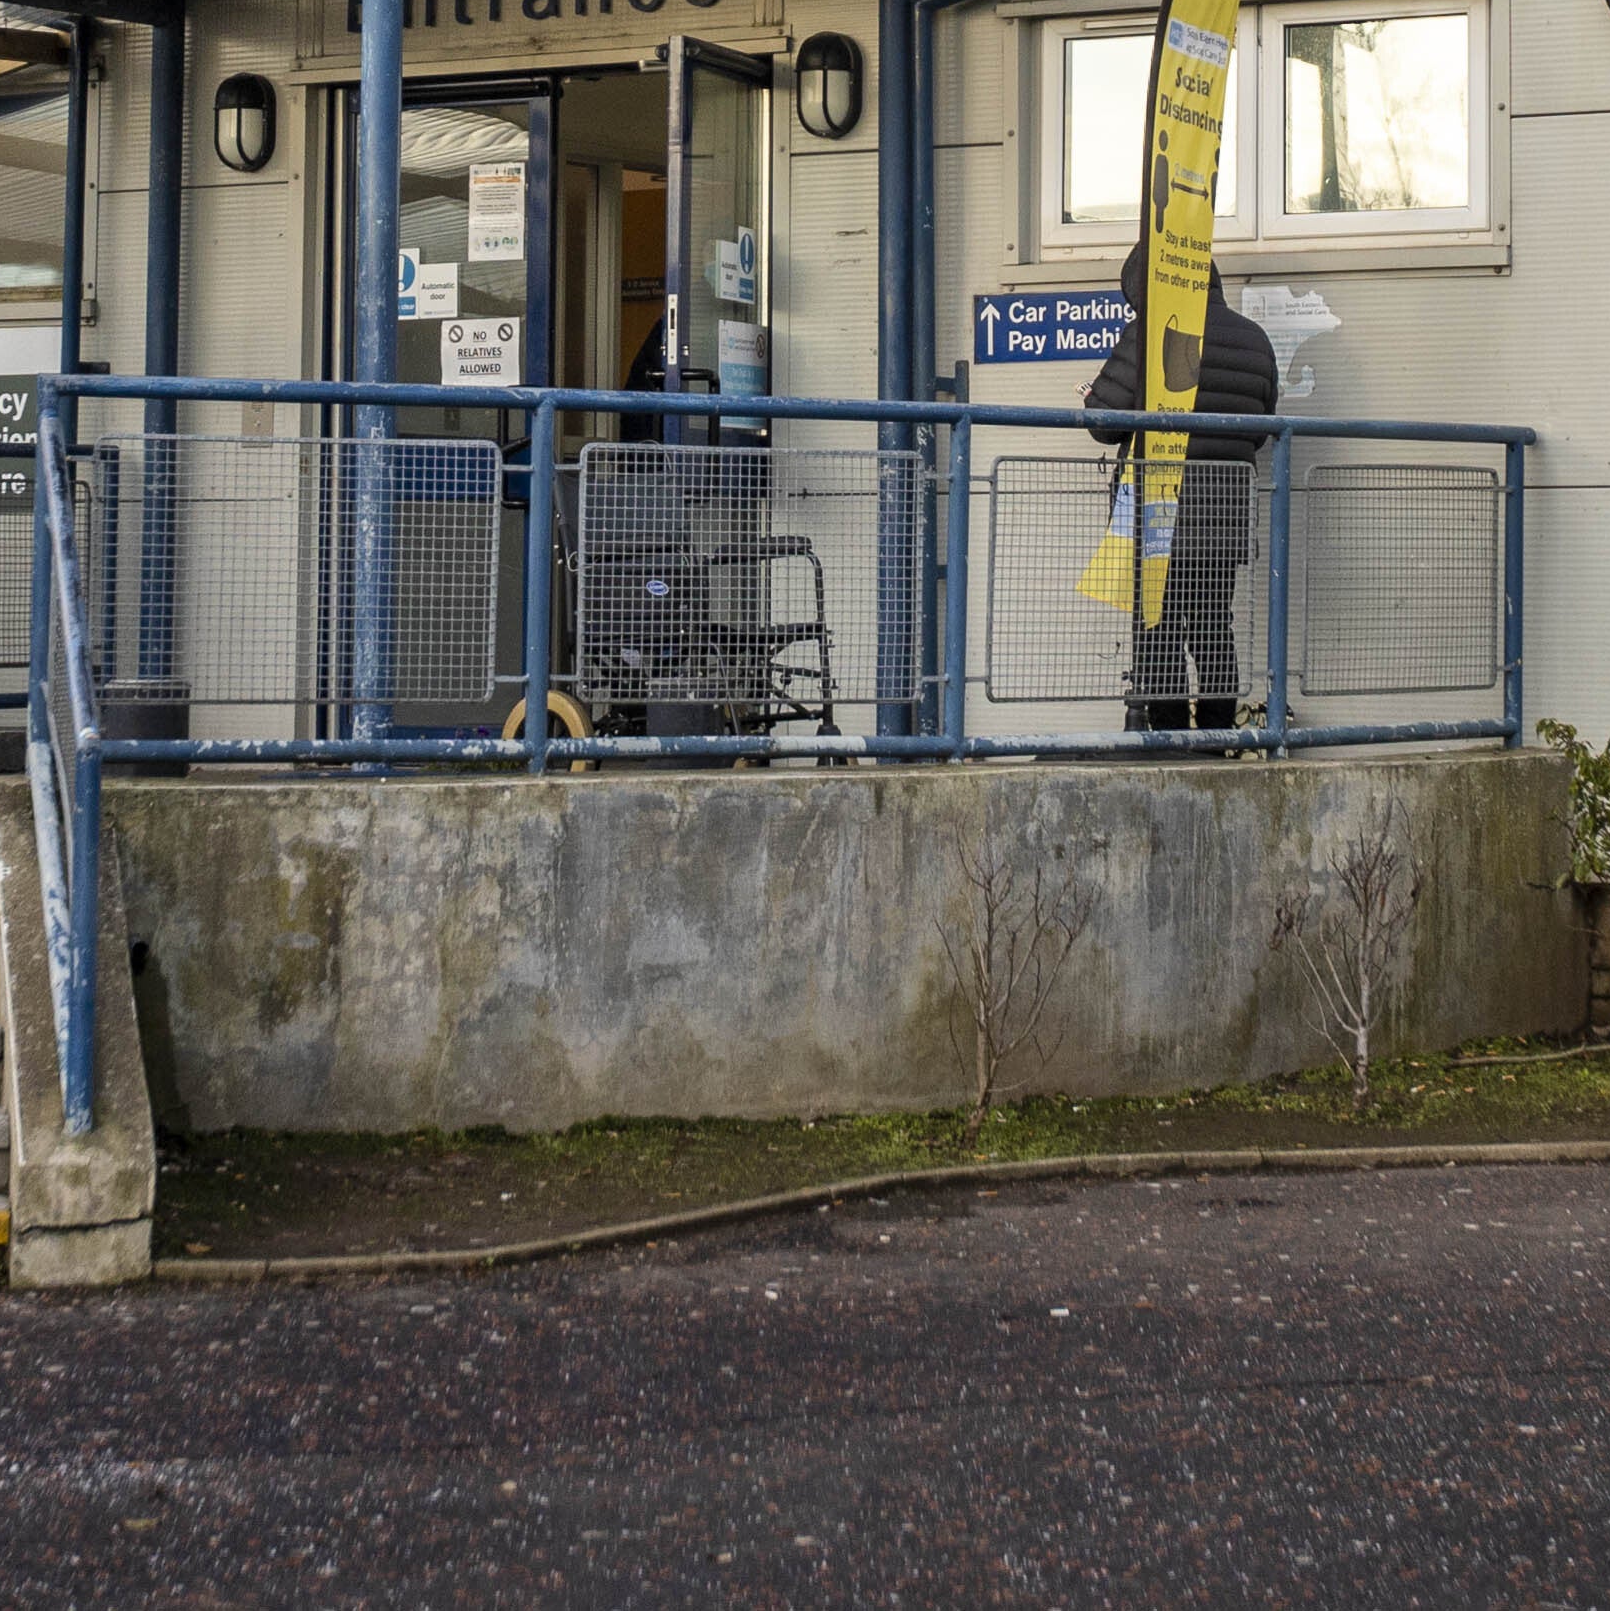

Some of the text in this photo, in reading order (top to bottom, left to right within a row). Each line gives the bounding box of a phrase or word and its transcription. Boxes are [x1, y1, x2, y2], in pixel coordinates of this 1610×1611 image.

[1175, 66, 1214, 97] Social
[1159, 93, 1223, 142] Distancing
[1180, 236, 1188, 248] at
[1008, 298, 1138, 324] Car Parking
[473, 331, 487, 341] NO
[1008, 330, 1047, 355] Pay
[458, 347, 502, 357] RELATIVES
[459, 363, 501, 374] ALLOWED
